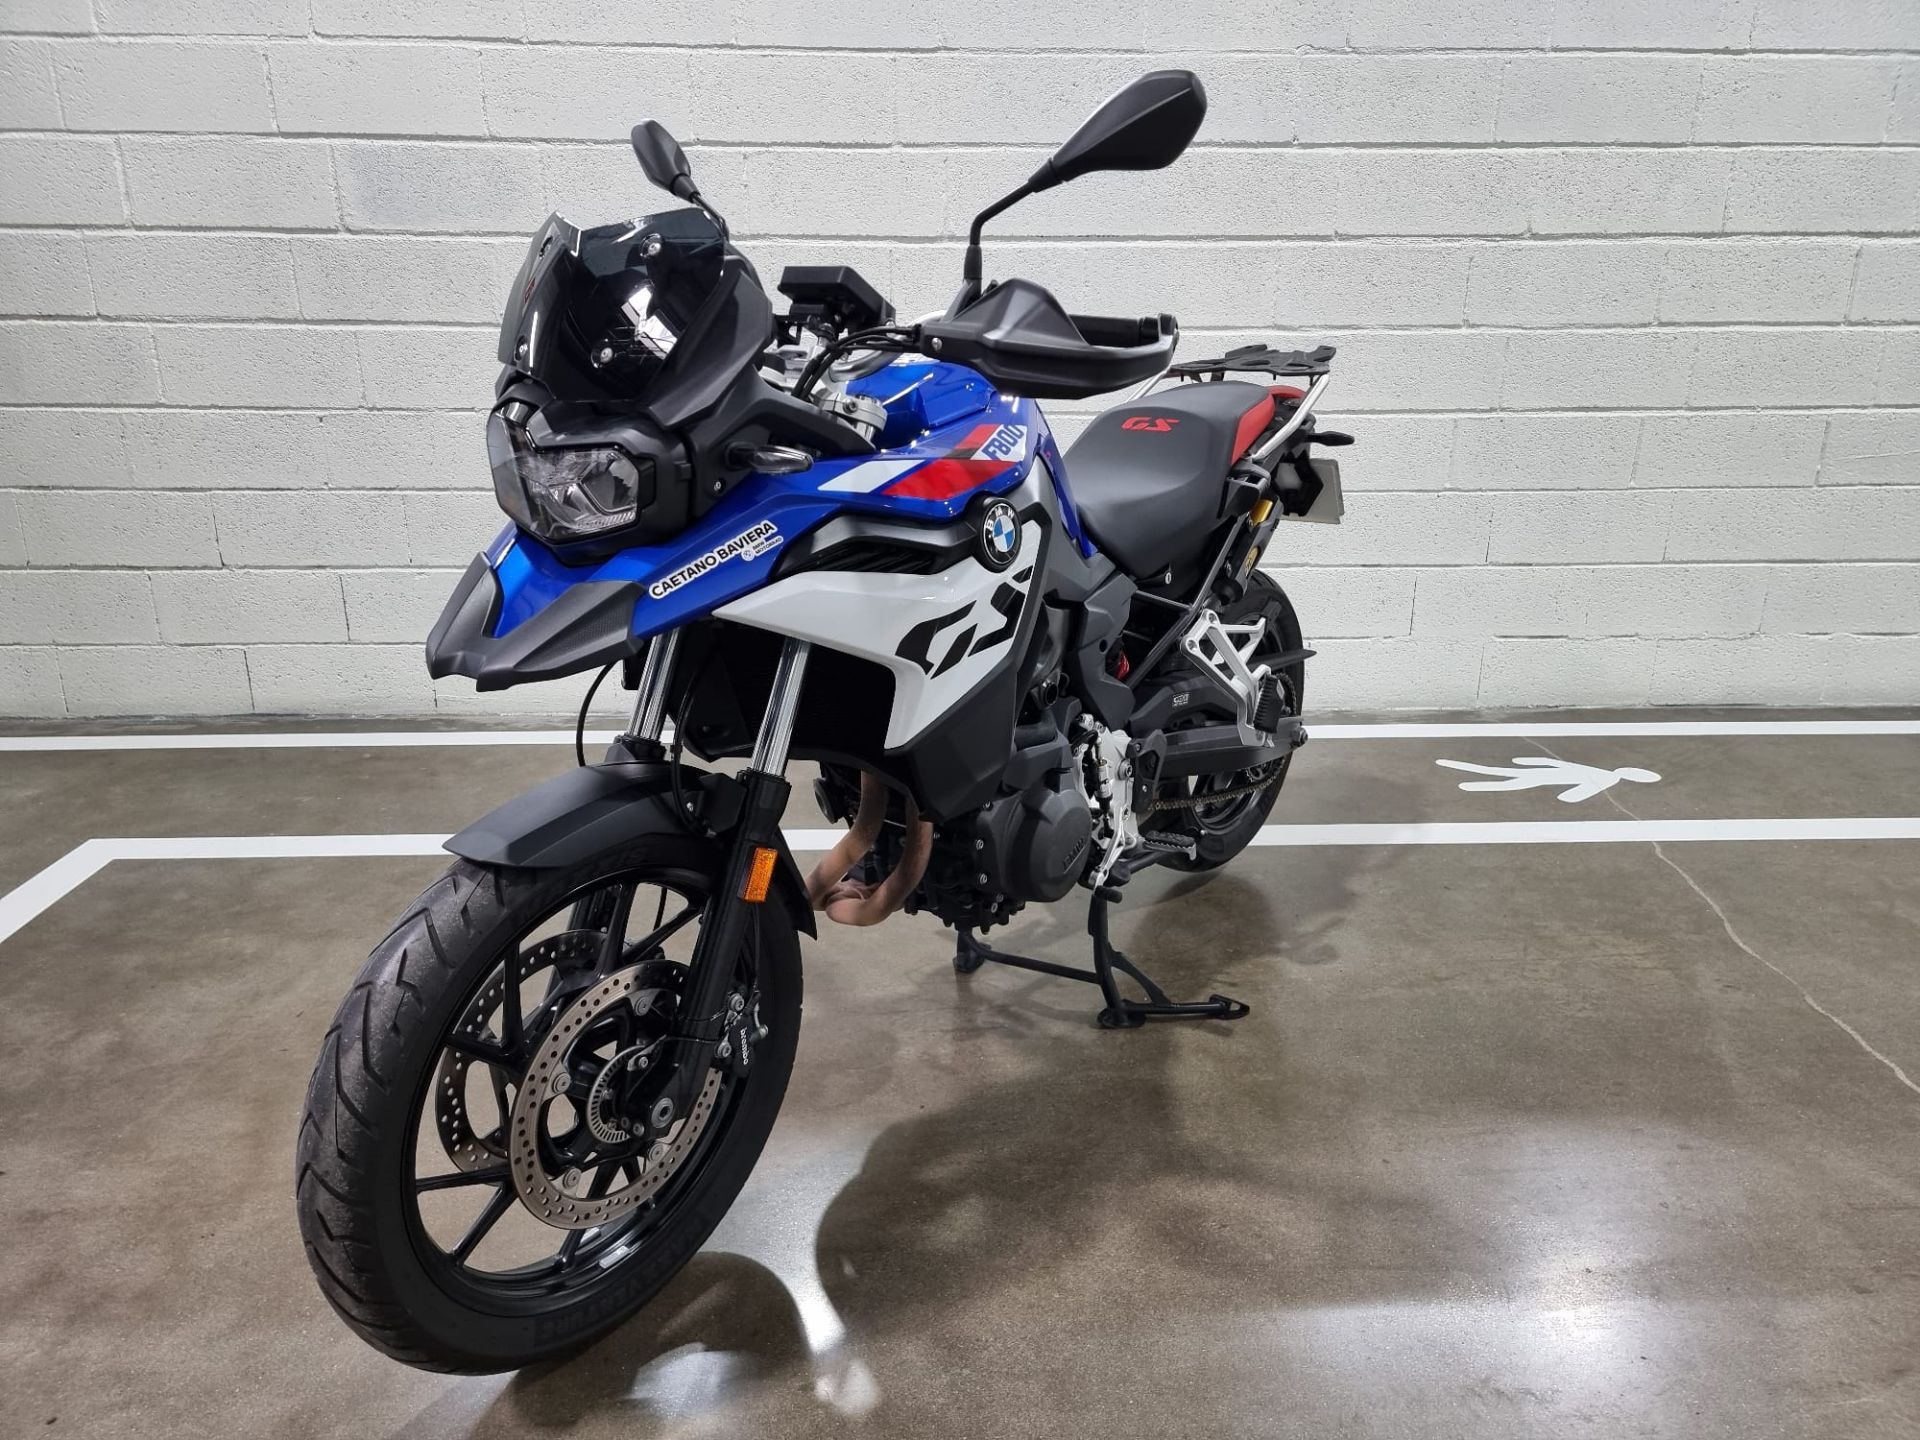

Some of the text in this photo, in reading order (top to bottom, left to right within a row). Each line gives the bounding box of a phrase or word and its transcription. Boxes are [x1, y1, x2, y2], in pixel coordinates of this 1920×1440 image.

[981, 424, 1025, 460] F800
[1121, 416, 1180, 432] GS
[651, 521, 776, 597] CAETANO BAVIERA
[895, 565, 1034, 680] GS
[740, 1026, 749, 1066] brembo
